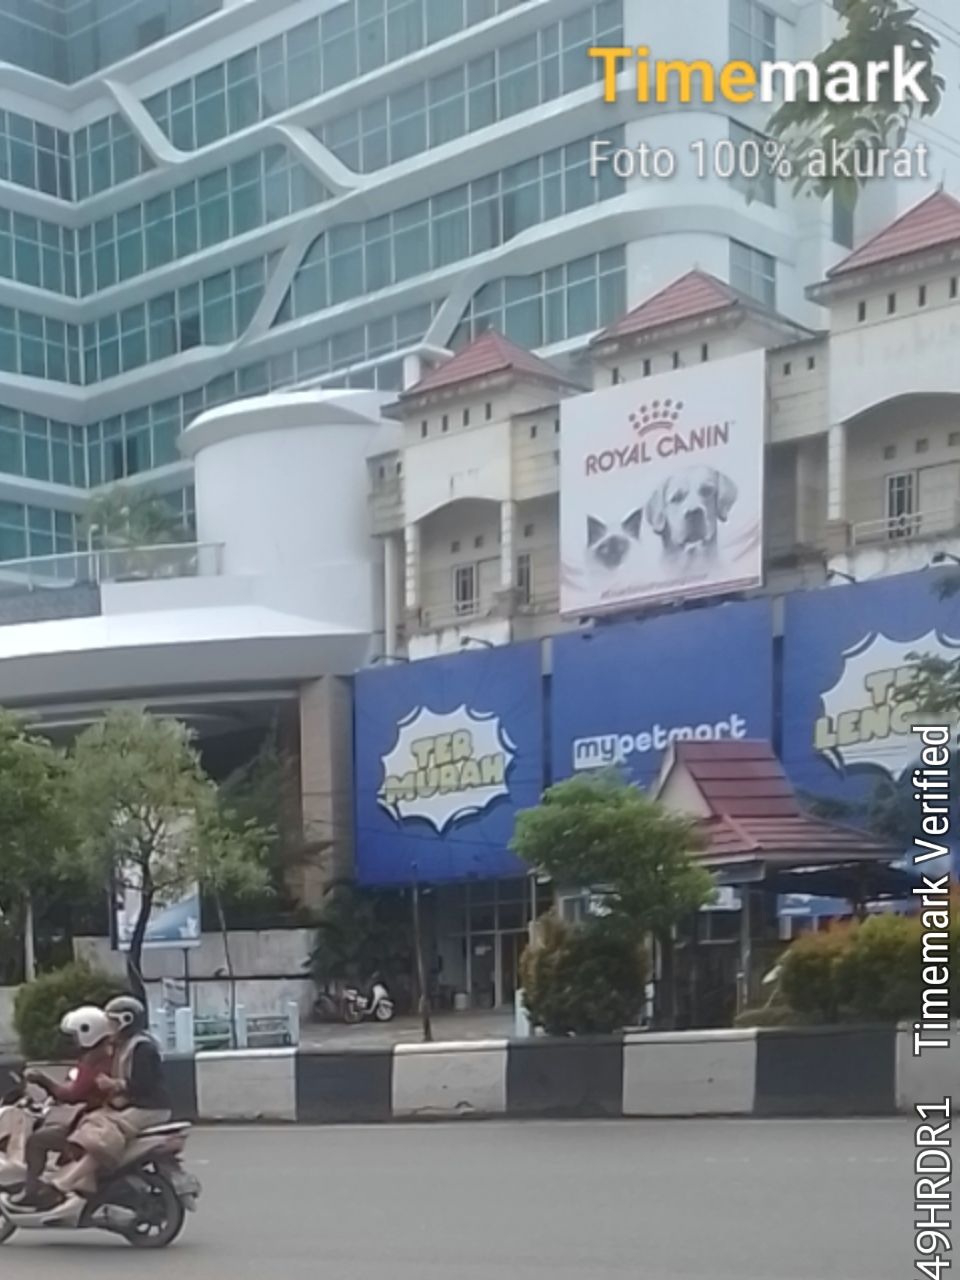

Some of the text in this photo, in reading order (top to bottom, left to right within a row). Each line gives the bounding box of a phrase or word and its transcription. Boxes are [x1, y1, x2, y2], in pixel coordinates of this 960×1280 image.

[585, 421, 730, 476] ROYAL CANIN
[410, 728, 473, 770] TER
[385, 751, 505, 805] MURAH
